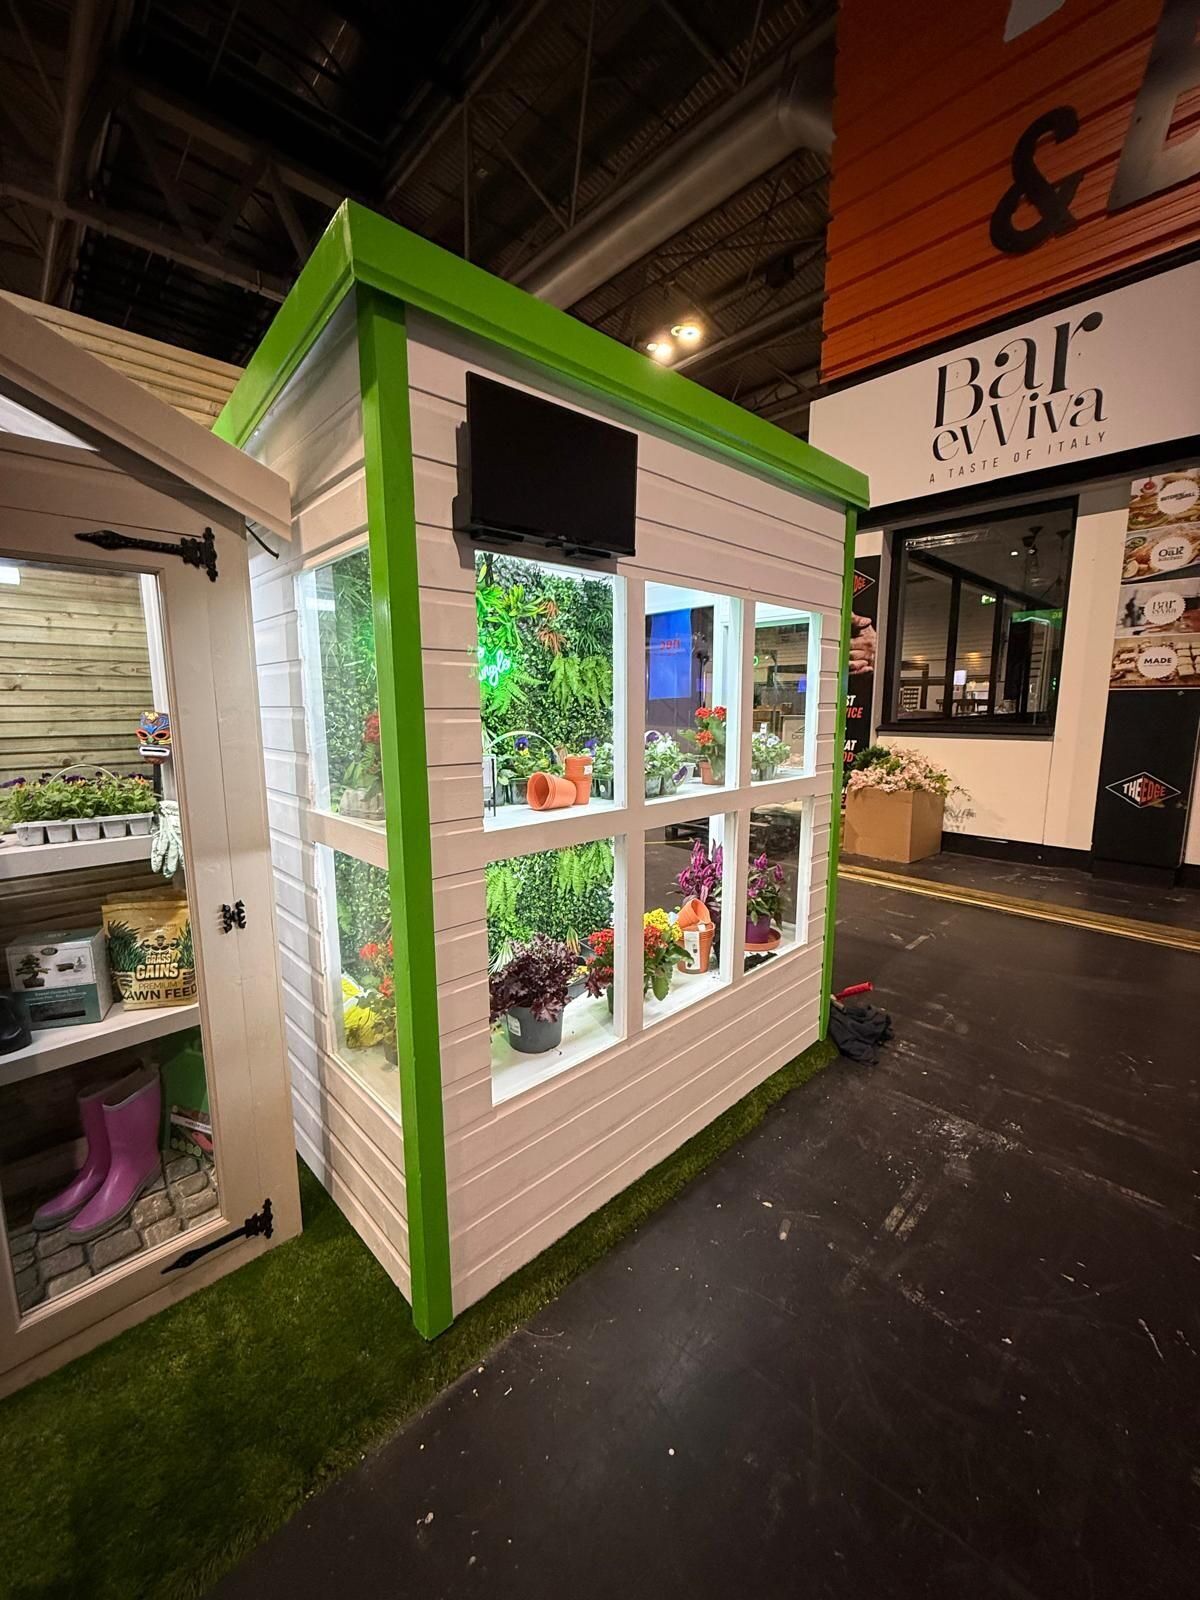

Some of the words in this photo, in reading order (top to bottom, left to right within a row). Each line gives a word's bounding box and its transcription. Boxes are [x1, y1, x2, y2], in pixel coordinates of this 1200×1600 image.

[988, 105, 1085, 256] &
[934, 311, 1104, 429] Bar
[929, 473, 936, 484] A
[949, 457, 999, 479] TASTE
[1013, 449, 1033, 463] OF
[1048, 431, 1106, 455] ITALY
[1143, 657, 1172, 665] MADE
[1122, 776, 1144, 802] THE
[1140, 777, 1167, 802] EDGE
[145, 954, 171, 965] GRASS
[135, 962, 179, 981] GAINS
[138, 982, 178, 990] PREMIUM
[165, 984, 197, 999] FEED
